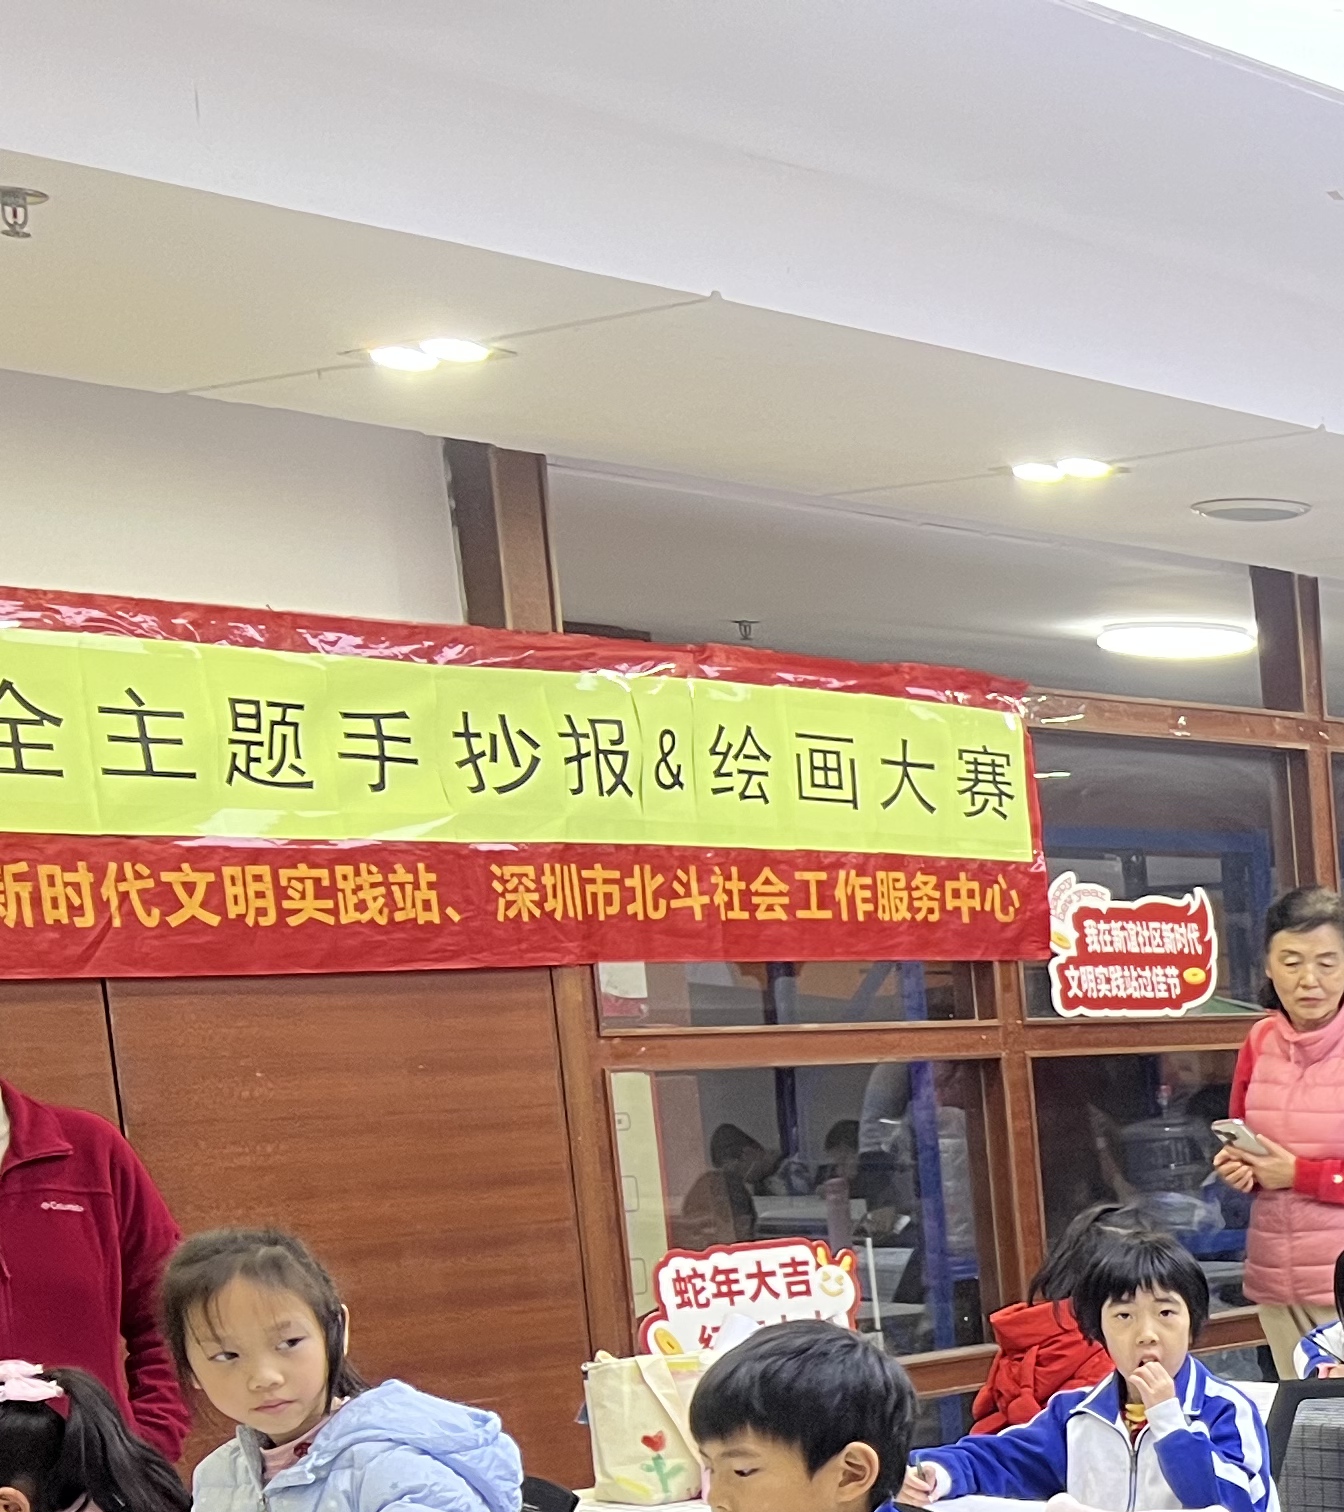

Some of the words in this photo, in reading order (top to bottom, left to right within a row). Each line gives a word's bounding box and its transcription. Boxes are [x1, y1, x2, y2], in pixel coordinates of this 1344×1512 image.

[0, 678, 1017, 821] 全主题手抄报&绘画大赛
[1064, 964, 1182, 999] 文明实践站过佳节
[671, 1256, 813, 1311] 蛇年大吉
